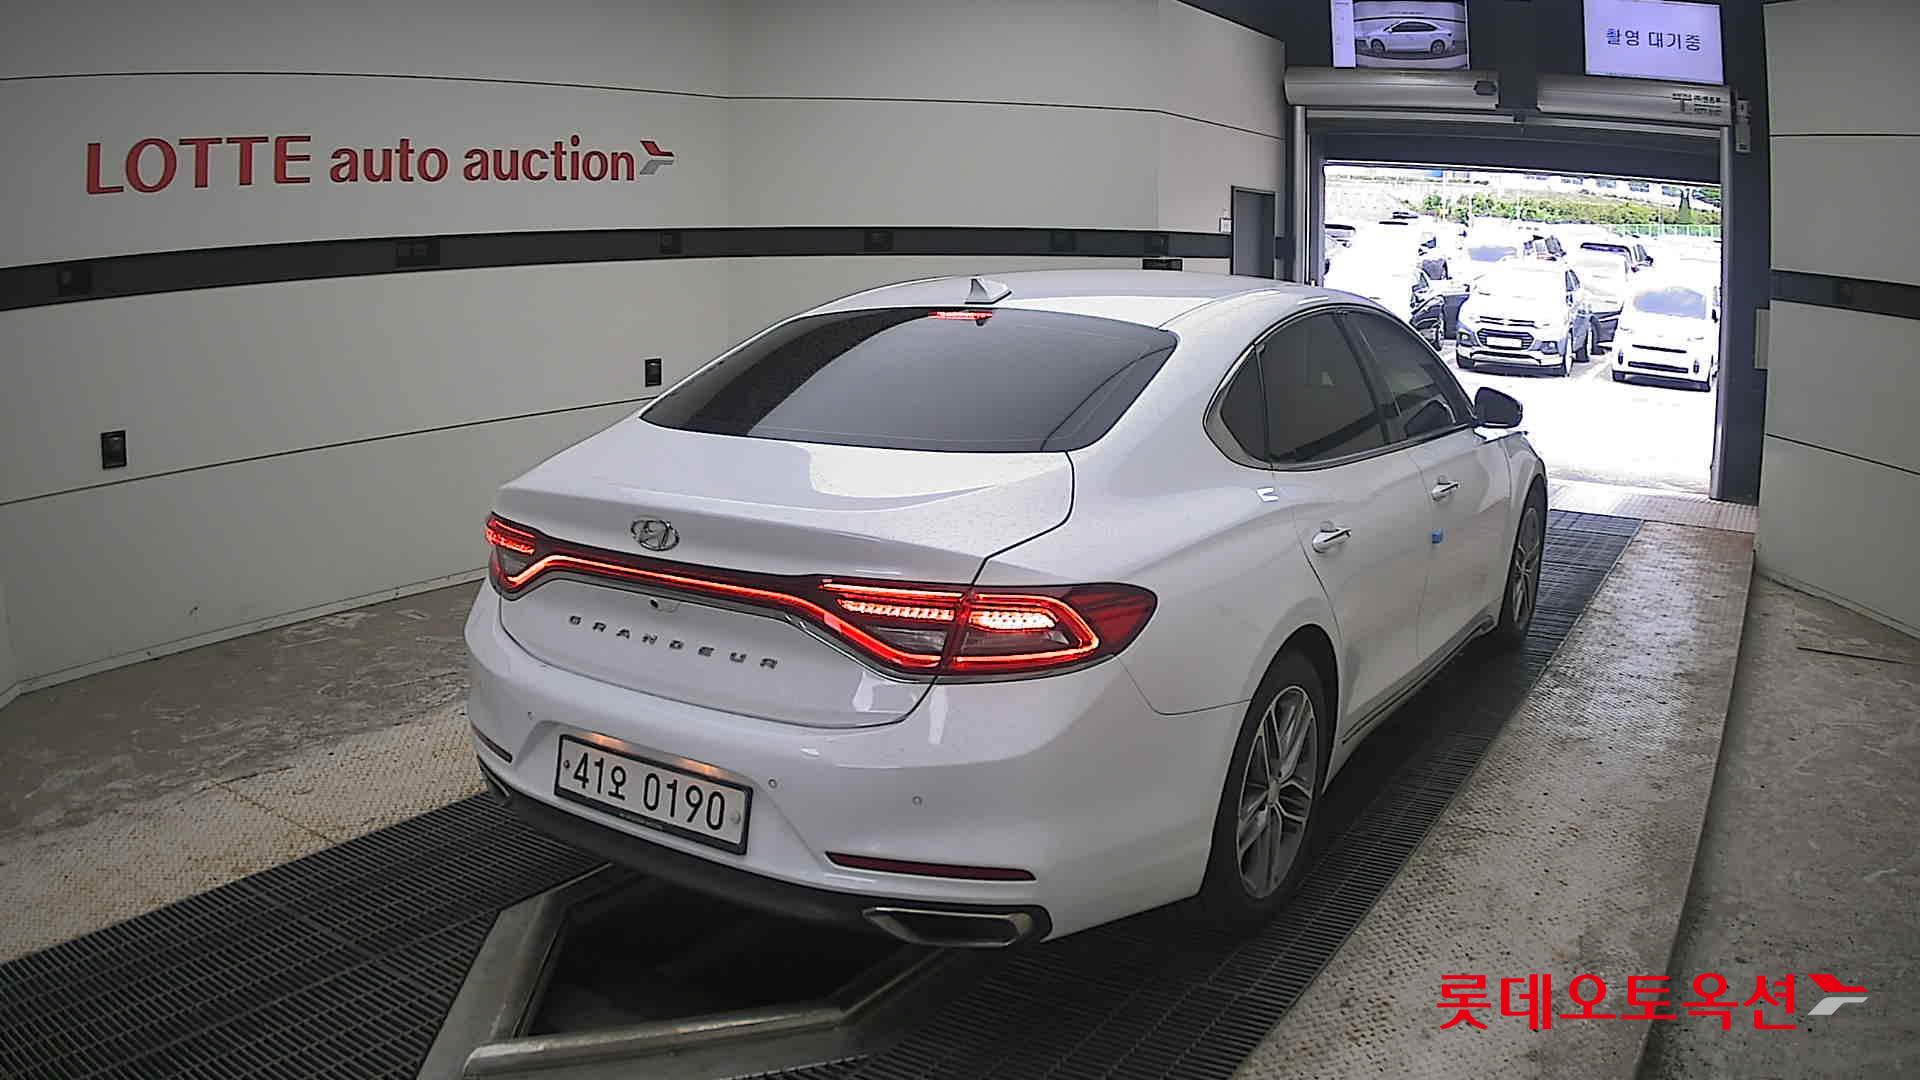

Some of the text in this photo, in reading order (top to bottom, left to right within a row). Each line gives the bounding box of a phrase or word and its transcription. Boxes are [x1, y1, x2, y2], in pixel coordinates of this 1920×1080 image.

[1648, 31, 1701, 51] 대기중
[86, 135, 635, 194] LOTTE auto auction
[569, 615, 778, 669] GRANDEUR
[573, 752, 628, 801] 41오
[643, 773, 726, 831] 0190
